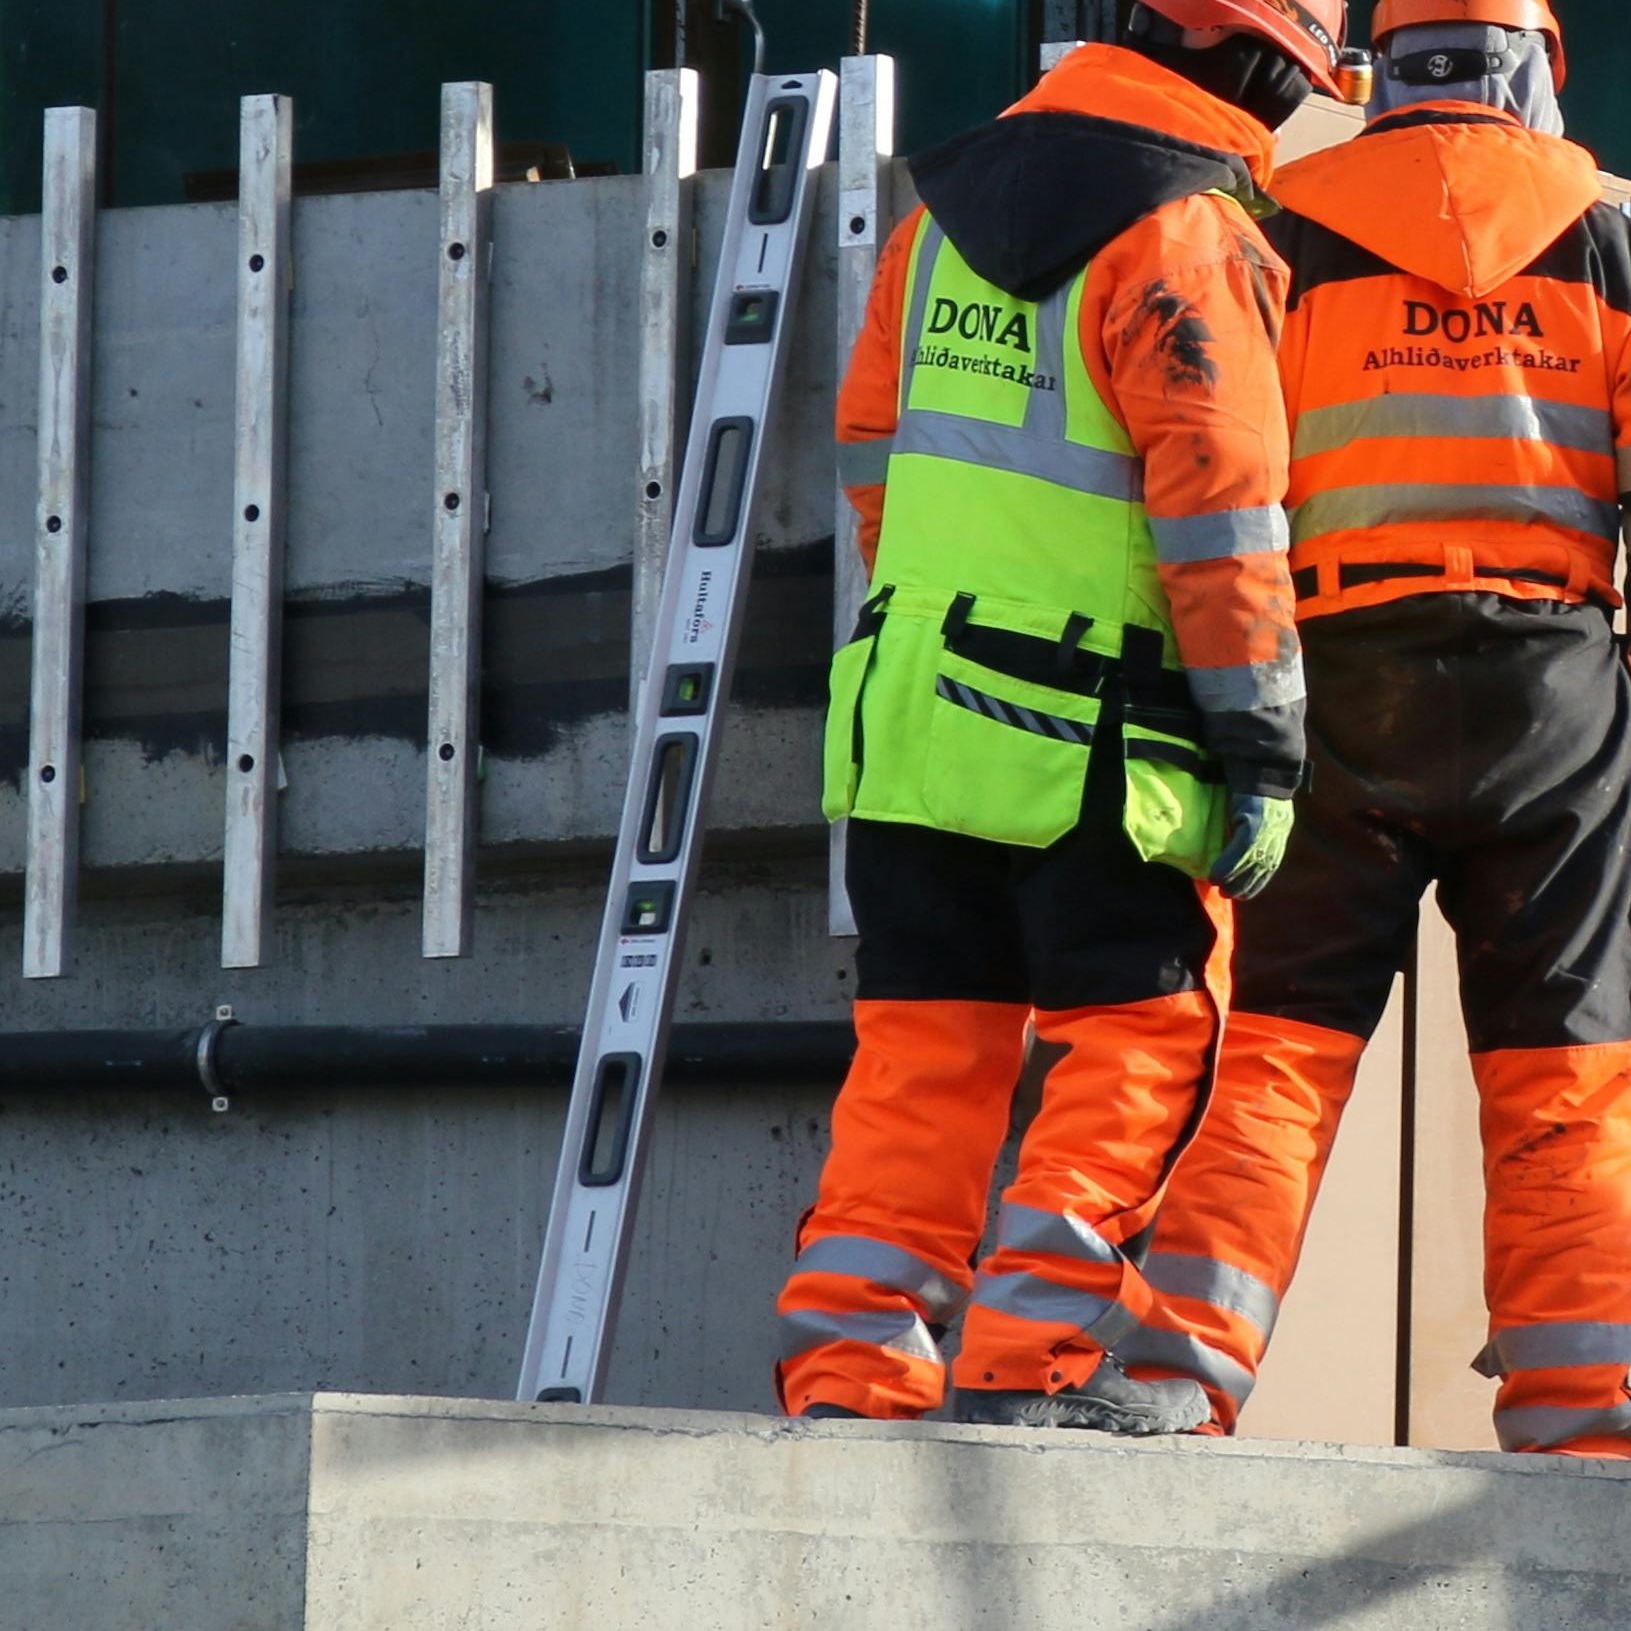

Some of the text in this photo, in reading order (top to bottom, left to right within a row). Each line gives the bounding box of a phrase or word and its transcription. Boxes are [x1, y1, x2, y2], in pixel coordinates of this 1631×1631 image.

[928, 298, 1031, 353] DONA
[1403, 300, 1544, 343] DONA
[1362, 346, 1581, 373] Alhliðaverktakar
[690, 571, 711, 643] Hultafors
